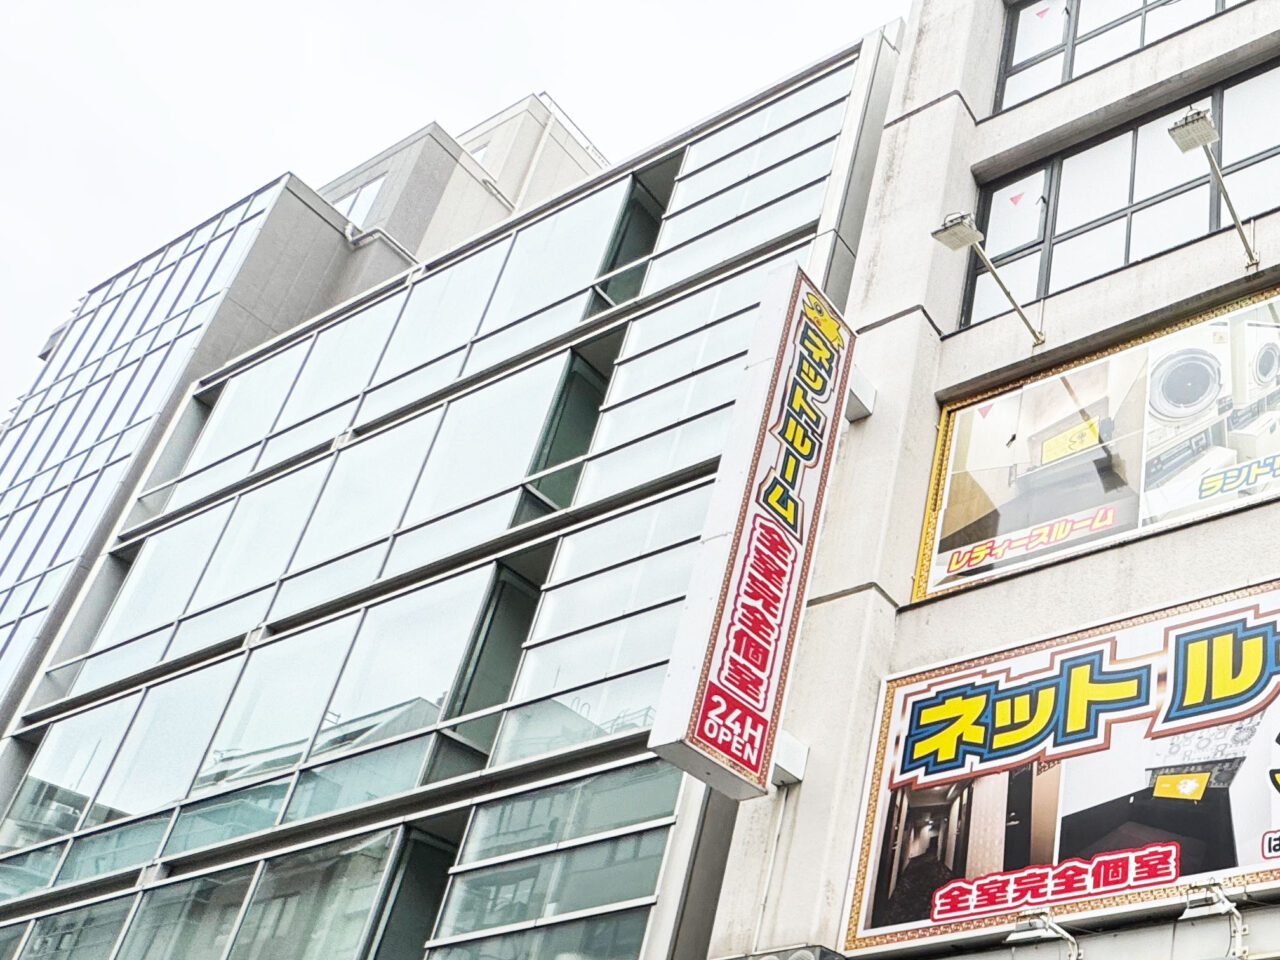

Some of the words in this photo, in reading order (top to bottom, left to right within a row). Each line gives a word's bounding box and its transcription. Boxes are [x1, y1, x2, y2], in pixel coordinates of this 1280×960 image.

[760, 317, 836, 537] ネットルーム
[948, 507, 1115, 573] レディースルーム
[720, 517, 796, 707] 全室完全個室
[704, 718, 759, 766] OPEN
[707, 695, 764, 749] 24H
[935, 846, 1174, 918] 全室完全個室
